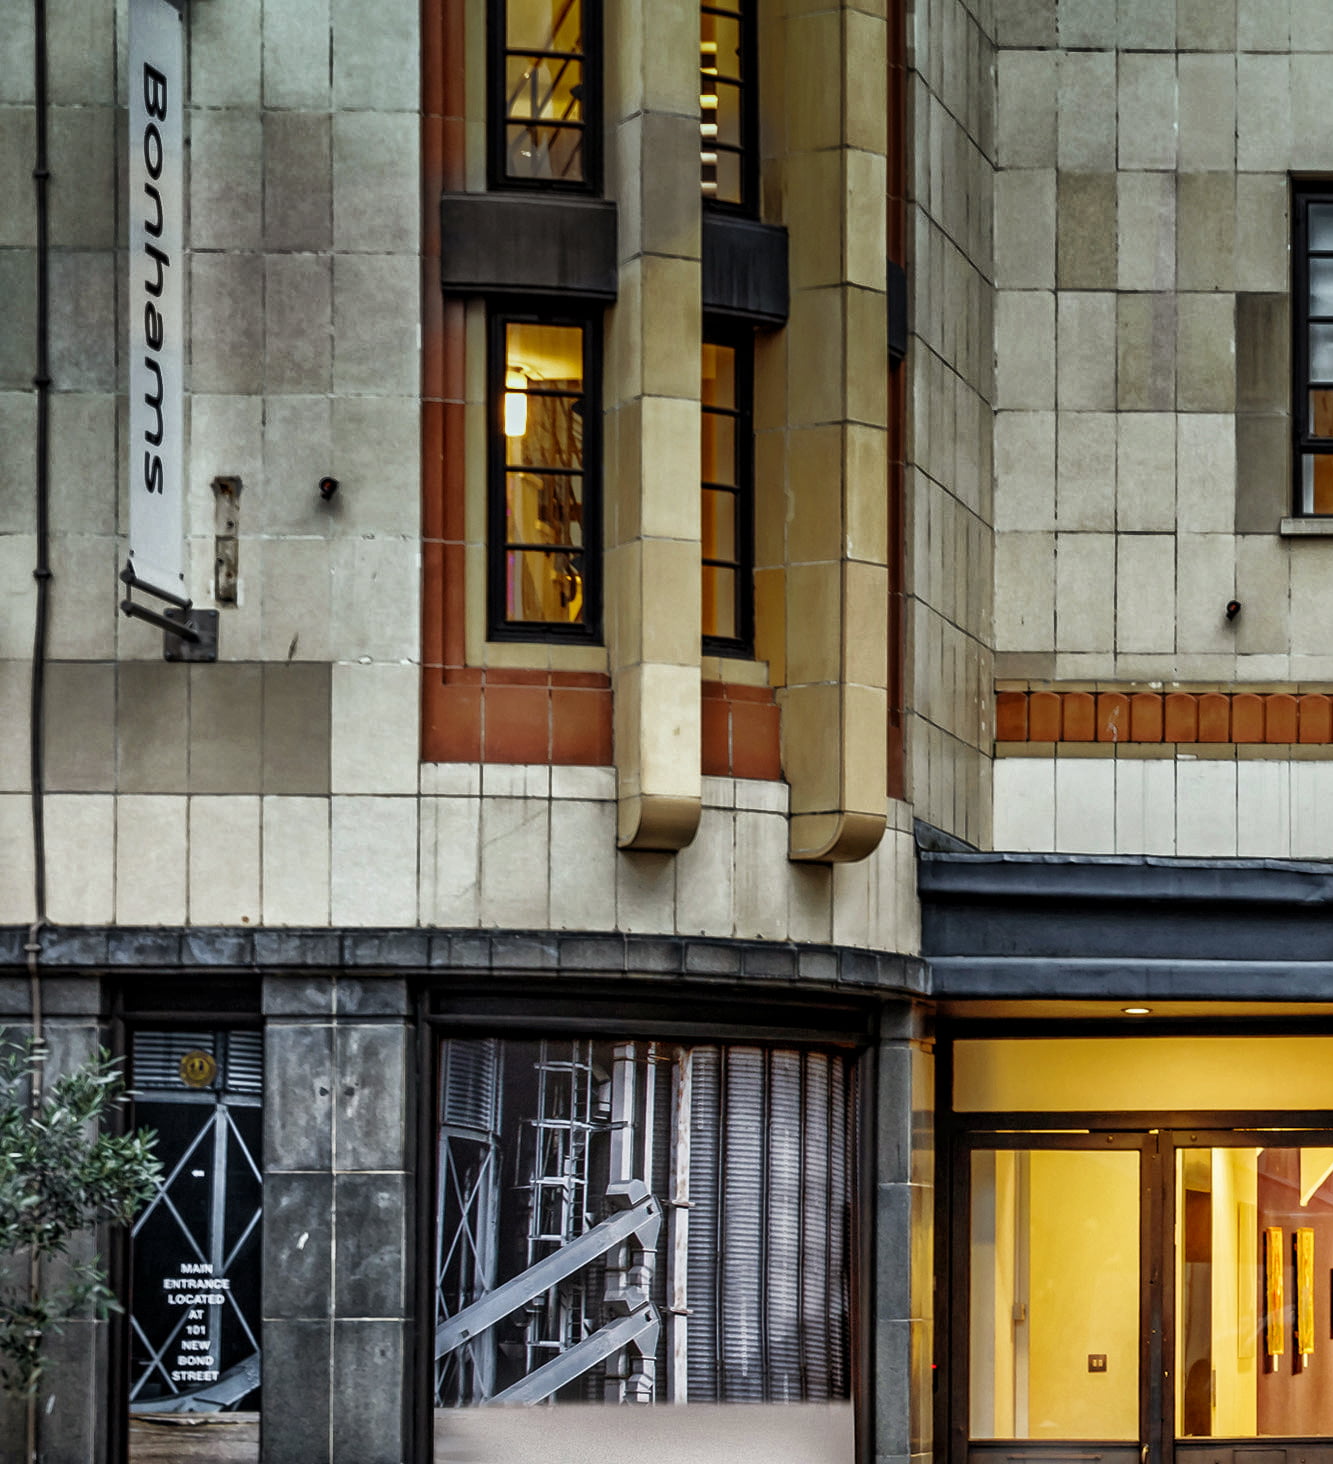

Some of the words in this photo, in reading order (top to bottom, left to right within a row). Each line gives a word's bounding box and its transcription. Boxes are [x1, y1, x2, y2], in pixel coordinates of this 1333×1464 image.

[143, 62, 170, 495] Bonhams
[180, 1263, 214, 1274] MAIN
[163, 1278, 230, 1289] ENTRANCE
[167, 1294, 225, 1305] LOCATED
[187, 1309, 205, 1320] AT
[185, 1325, 206, 1335] 101
[181, 1340, 211, 1350] NEW
[177, 1355, 215, 1366] BOND
[171, 1370, 220, 1381] STREET
